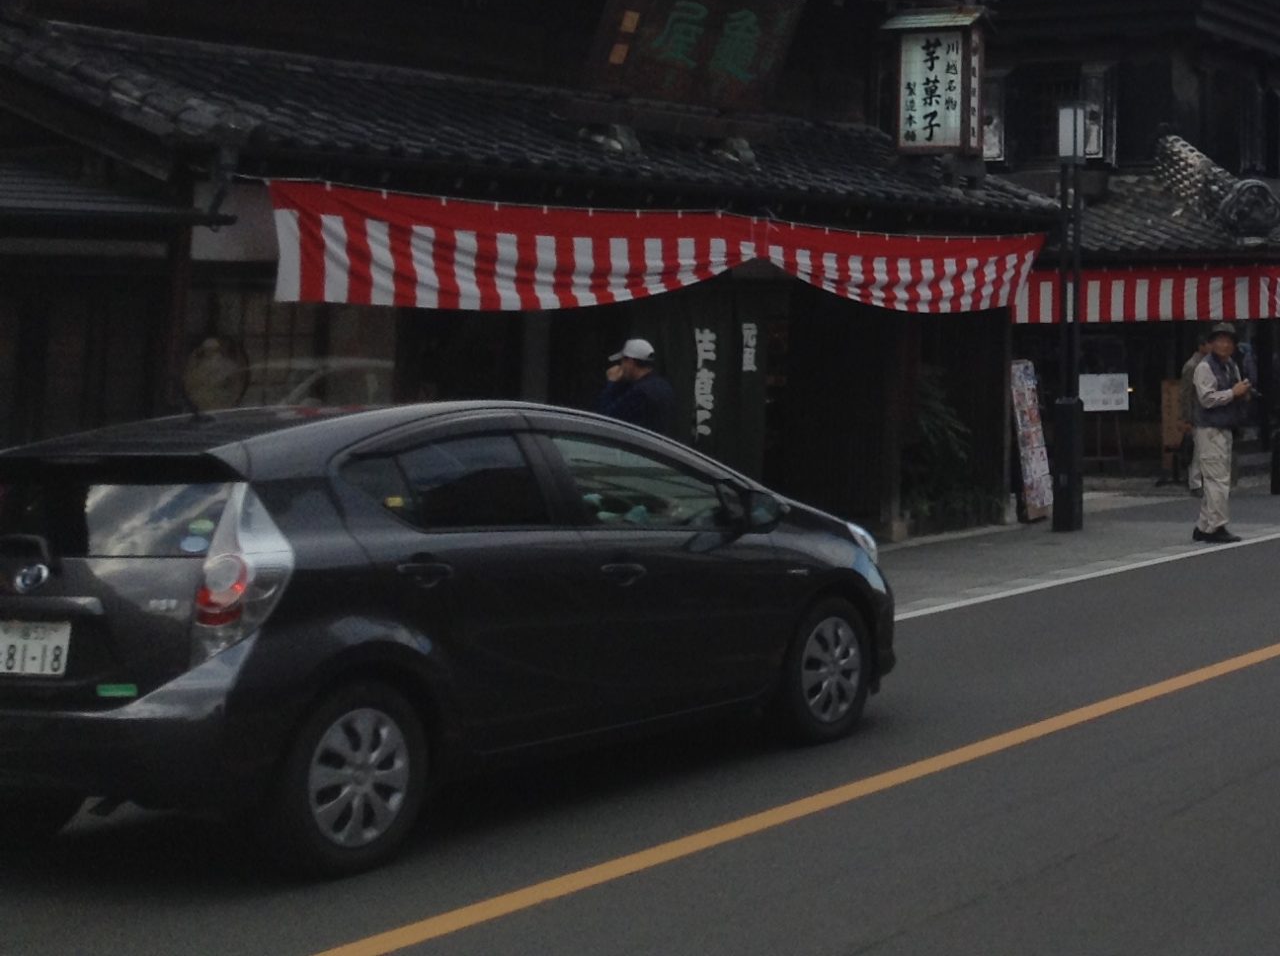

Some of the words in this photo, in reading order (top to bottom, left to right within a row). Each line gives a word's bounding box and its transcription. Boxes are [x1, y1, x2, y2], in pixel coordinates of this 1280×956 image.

[921, 37, 942, 142] 芋菓子
[945, 40, 959, 112] 川越名物
